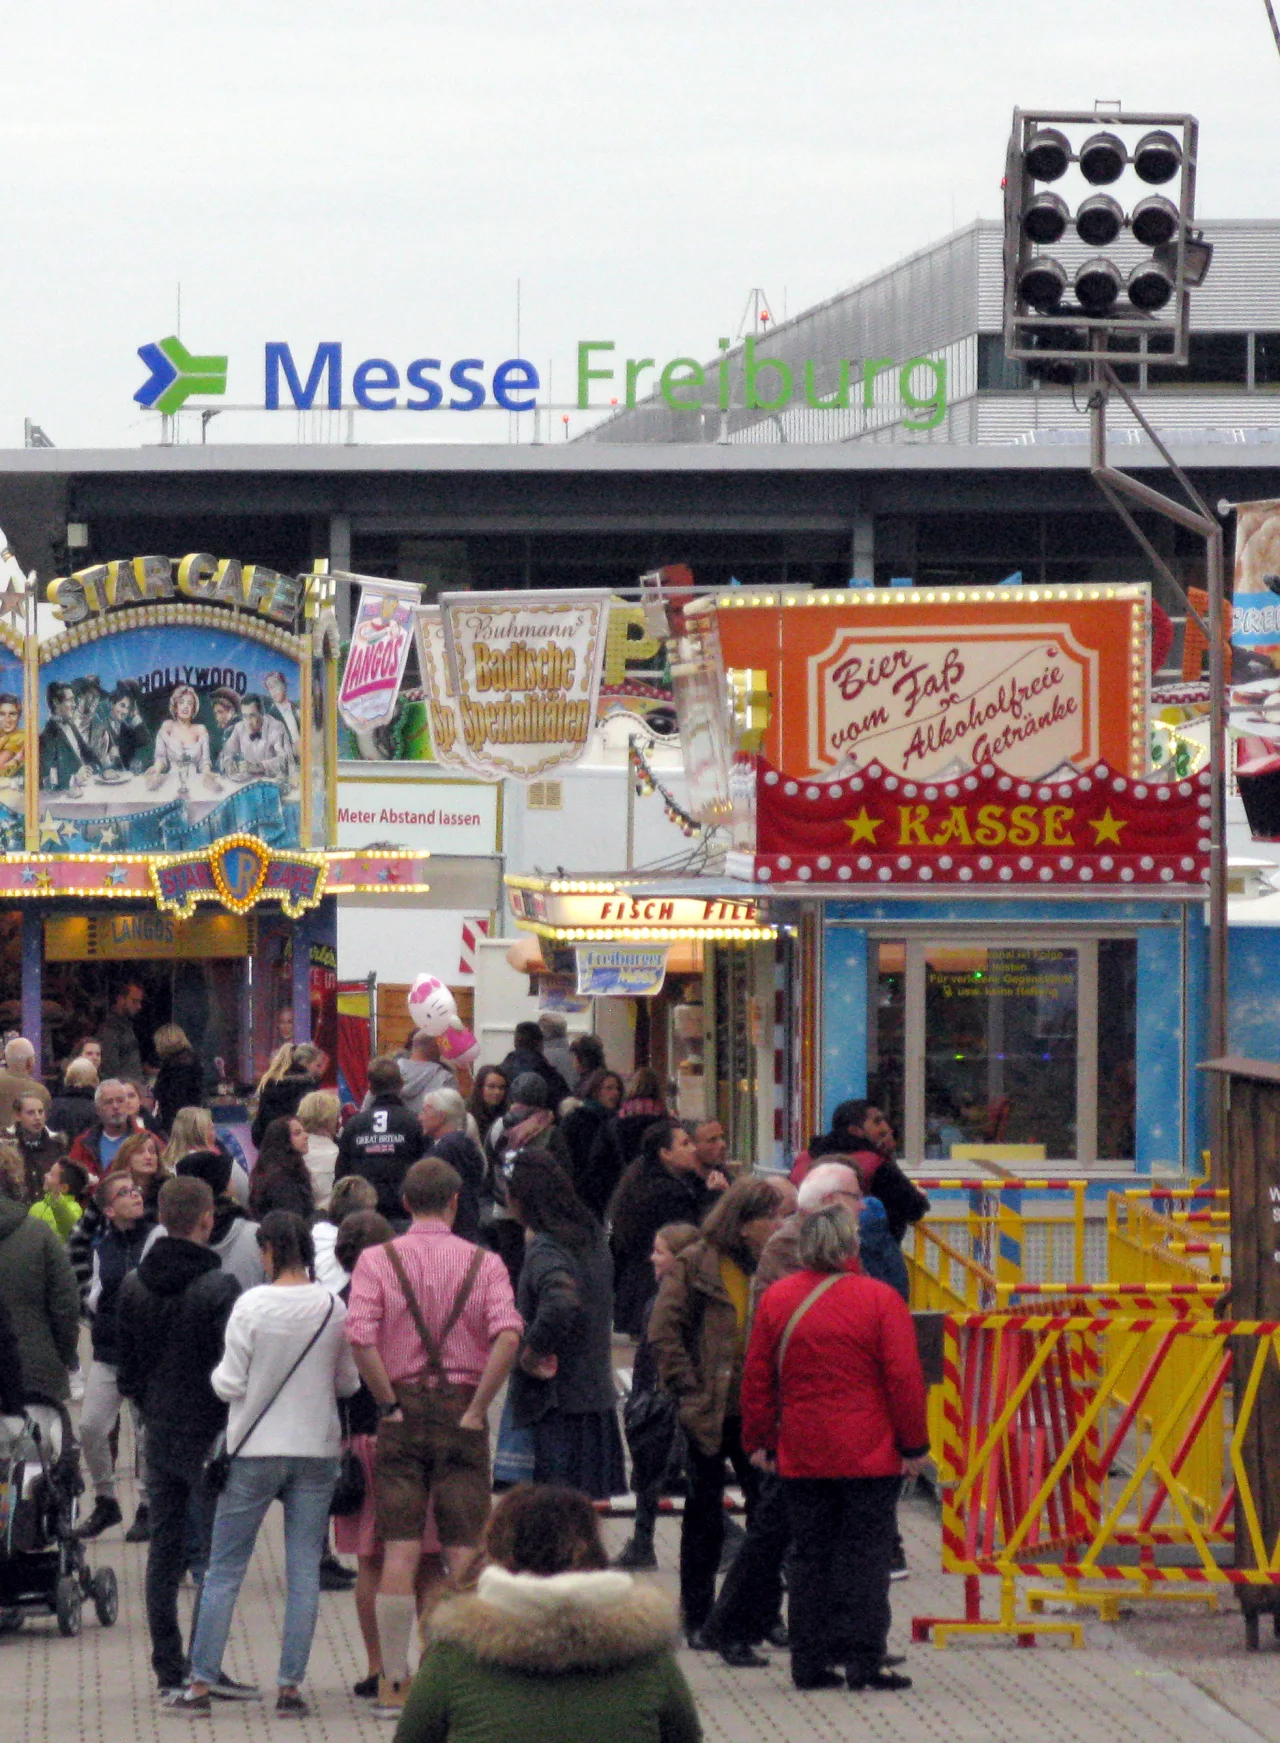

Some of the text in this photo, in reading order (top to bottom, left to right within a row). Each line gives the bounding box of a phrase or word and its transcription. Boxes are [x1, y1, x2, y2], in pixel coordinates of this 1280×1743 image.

[264, 335, 946, 430] Messe Freiburg
[47, 552, 303, 622] STAR CAFE
[138, 665, 248, 695] HOLLYWOOD
[472, 640, 577, 693] Badische
[832, 649, 912, 701] Bier
[460, 692, 591, 752] Spezialitäten
[830, 648, 965, 750] vom Faß
[903, 666, 1064, 771] Alkoholfreie
[972, 694, 1078, 766] Getränke
[337, 808, 481, 826] Meter Abstand lassen
[897, 804, 1076, 846] KASSE
[163, 862, 211, 894] STAR
[269, 862, 314, 894] CAFE
[600, 901, 675, 921] FISCH
[356, 1134, 405, 1145] GREAT BRITAIN
[372, 1110, 388, 1133] 3
